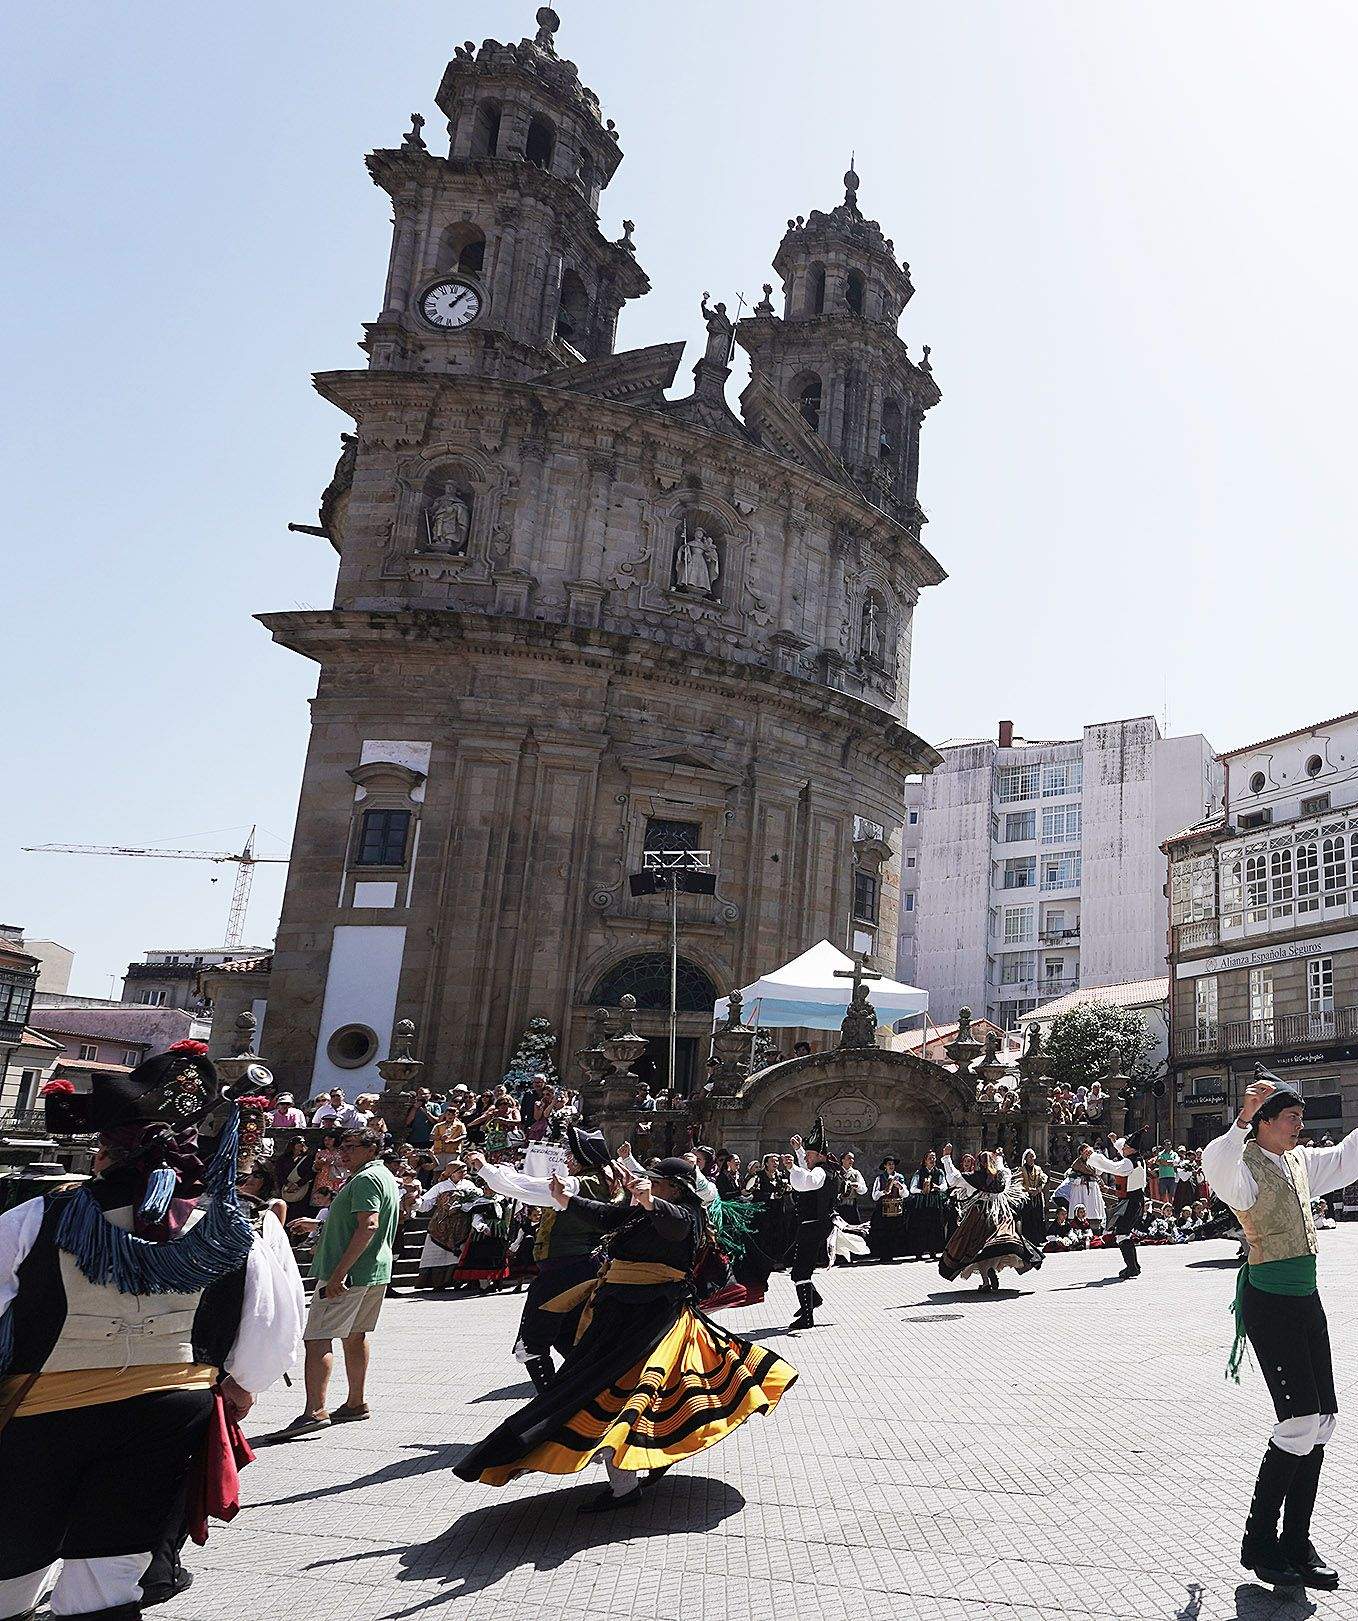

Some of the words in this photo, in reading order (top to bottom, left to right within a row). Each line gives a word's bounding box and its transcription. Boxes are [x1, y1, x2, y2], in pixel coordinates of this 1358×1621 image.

[1220, 955, 1249, 969] Alianza
[1251, 948, 1287, 965] Española
[1288, 942, 1322, 958] Seguros
